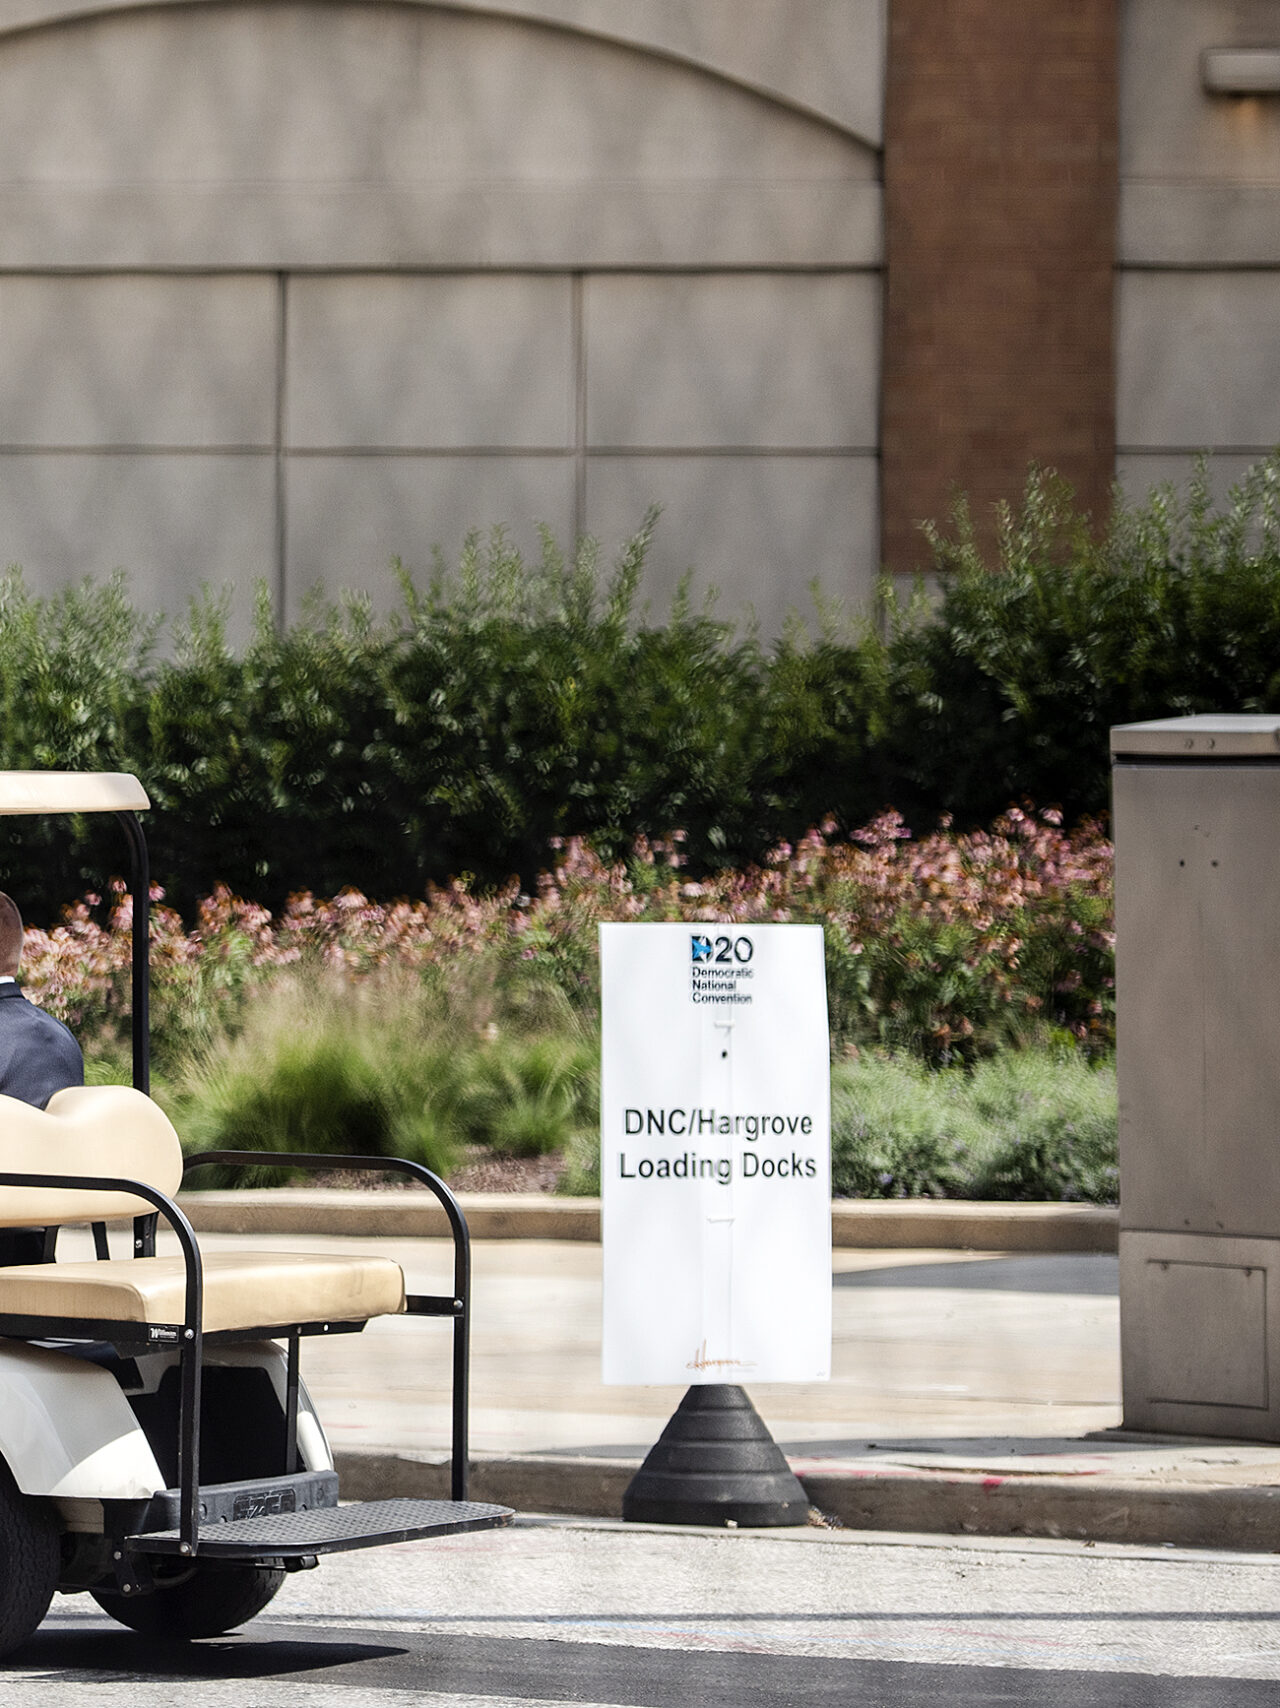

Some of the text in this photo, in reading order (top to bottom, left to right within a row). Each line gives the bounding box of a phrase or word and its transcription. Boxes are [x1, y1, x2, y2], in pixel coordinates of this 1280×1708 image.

[692, 967, 754, 978] Democratic
[692, 980, 736, 991] National
[692, 992, 753, 1004] Convention
[624, 1109, 813, 1142] DNC/Hargrove
[620, 1150, 817, 1186] Loading Docks
